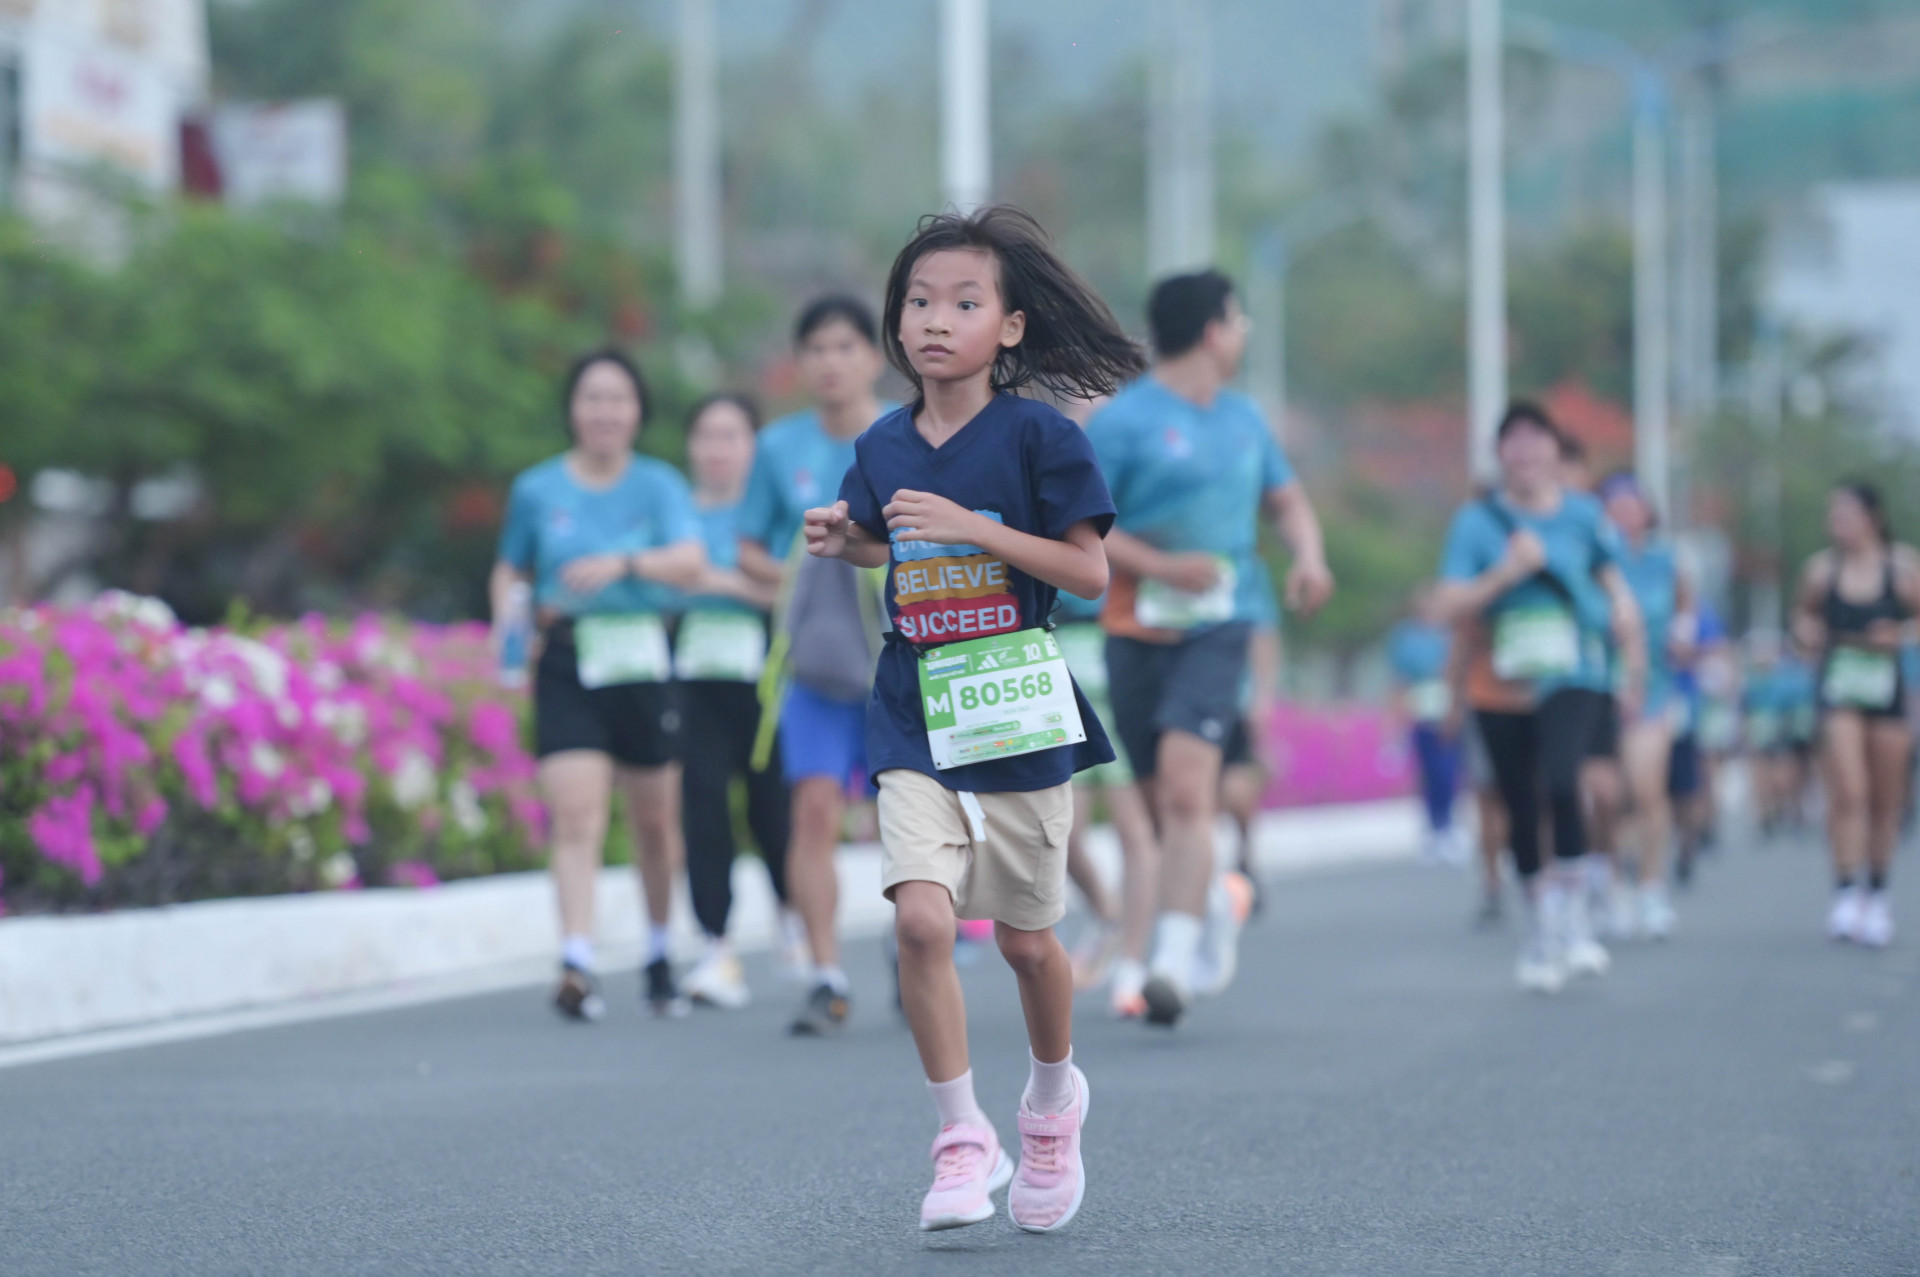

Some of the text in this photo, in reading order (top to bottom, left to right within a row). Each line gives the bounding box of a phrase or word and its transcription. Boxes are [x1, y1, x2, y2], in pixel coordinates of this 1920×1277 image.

[896, 561, 1005, 595] BELIEVE
[900, 604, 1017, 638] SUCCEED
[926, 695, 951, 716] M
[960, 671, 1053, 710] 80568
